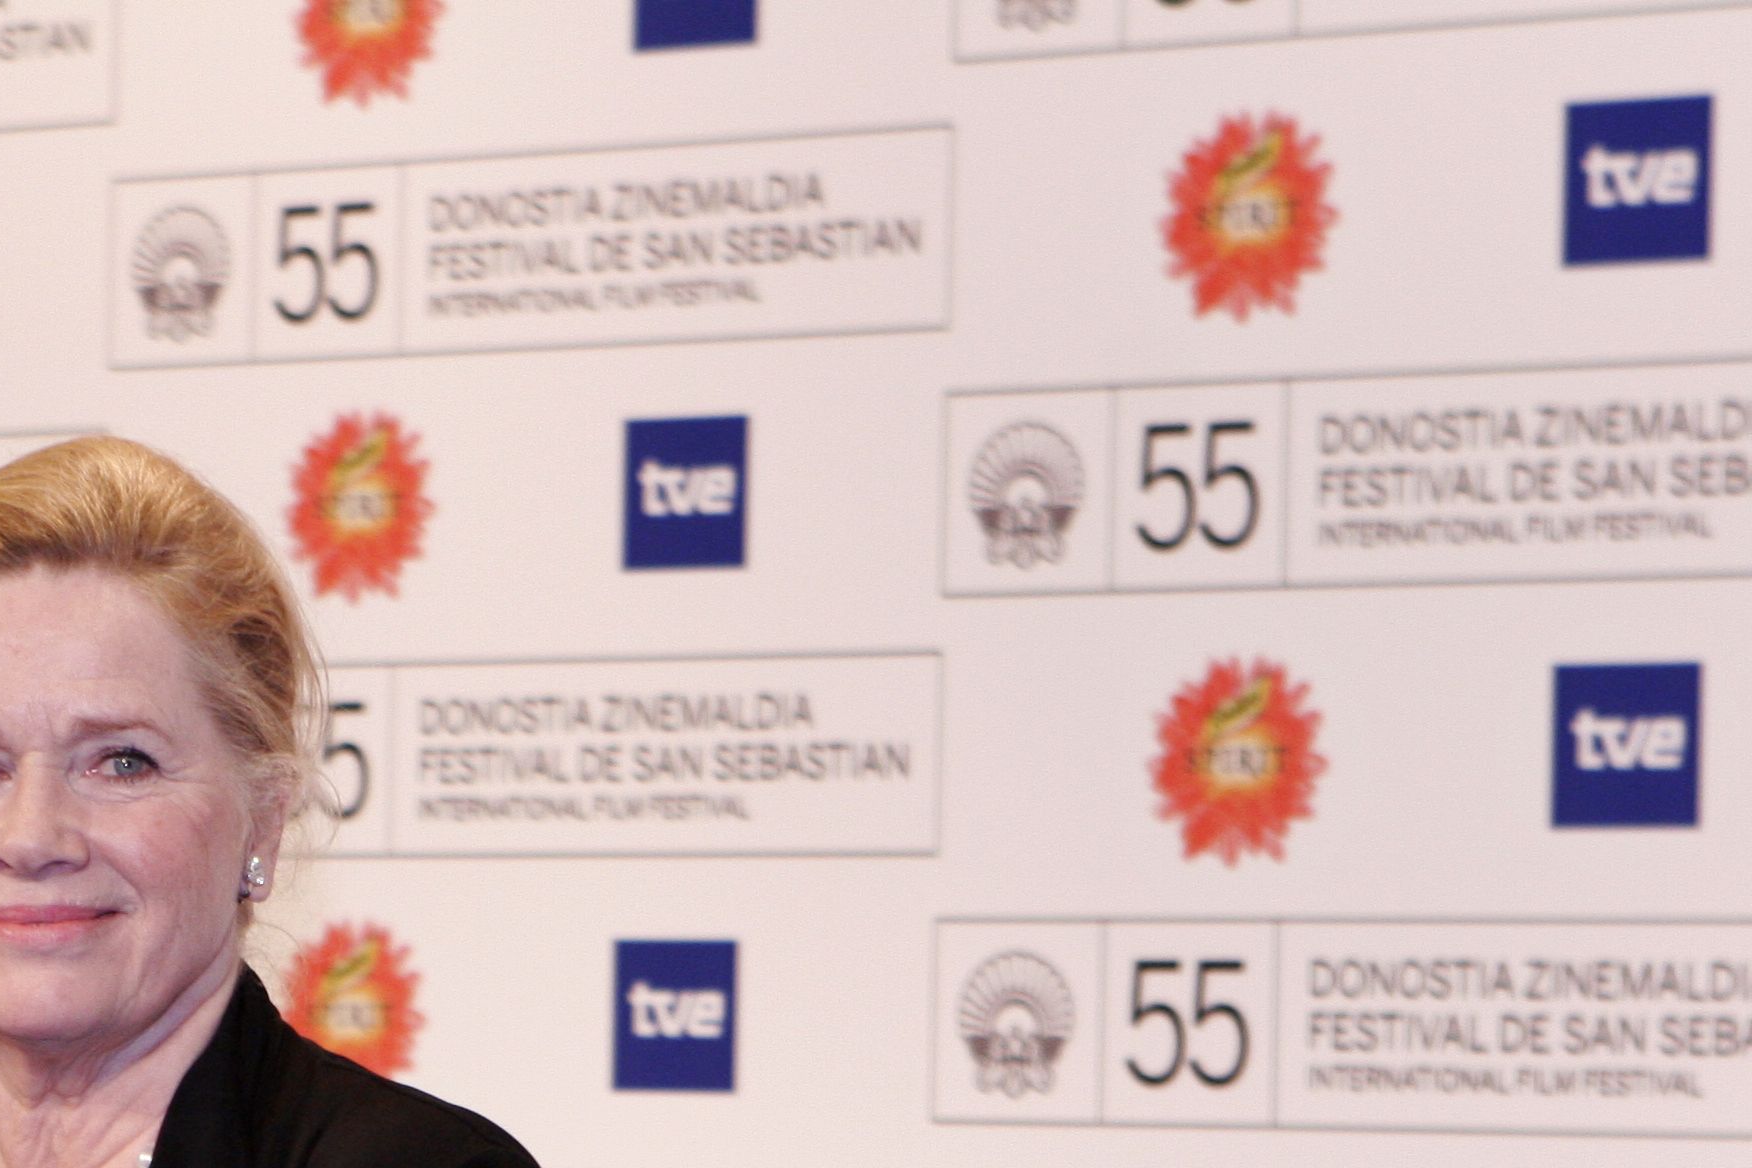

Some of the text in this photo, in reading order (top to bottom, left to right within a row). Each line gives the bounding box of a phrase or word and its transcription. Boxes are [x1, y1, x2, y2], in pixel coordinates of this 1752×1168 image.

[430, 171, 823, 232] DONOSTIA ZINEMALDIA
[1583, 147, 1698, 207] tve
[272, 201, 381, 324] 55
[429, 216, 922, 282] FESTIVAL DE SAN SEBASTIAN
[1319, 396, 1752, 455] DONOSTIA ZINEMALD
[639, 462, 736, 516] tve
[1132, 420, 1262, 551] 55
[1318, 462, 1499, 509] FESTIVAL
[1506, 460, 1560, 502] DE
[1570, 457, 1658, 500] SAN
[1316, 515, 1520, 549] INTERNATIONAL
[1590, 509, 1715, 540] FESTIVAL
[420, 692, 812, 735] DONOSTIA ZINEMALDIA
[1572, 710, 1686, 770] tve
[419, 742, 911, 785] FESTIVAL DE SAN SEBASTIAN
[1310, 959, 1752, 1002] DONOSTIA ZINEMALDI
[628, 983, 725, 1038] tve
[1123, 960, 1252, 1087] 55
[1309, 1012, 1489, 1053] FESTIVAL
[1496, 1013, 1550, 1054] DE
[1560, 1014, 1648, 1055] SAN
[1307, 1064, 1511, 1094] INTERNATIONAL
[1580, 1068, 1705, 1097] FESTIVAL
